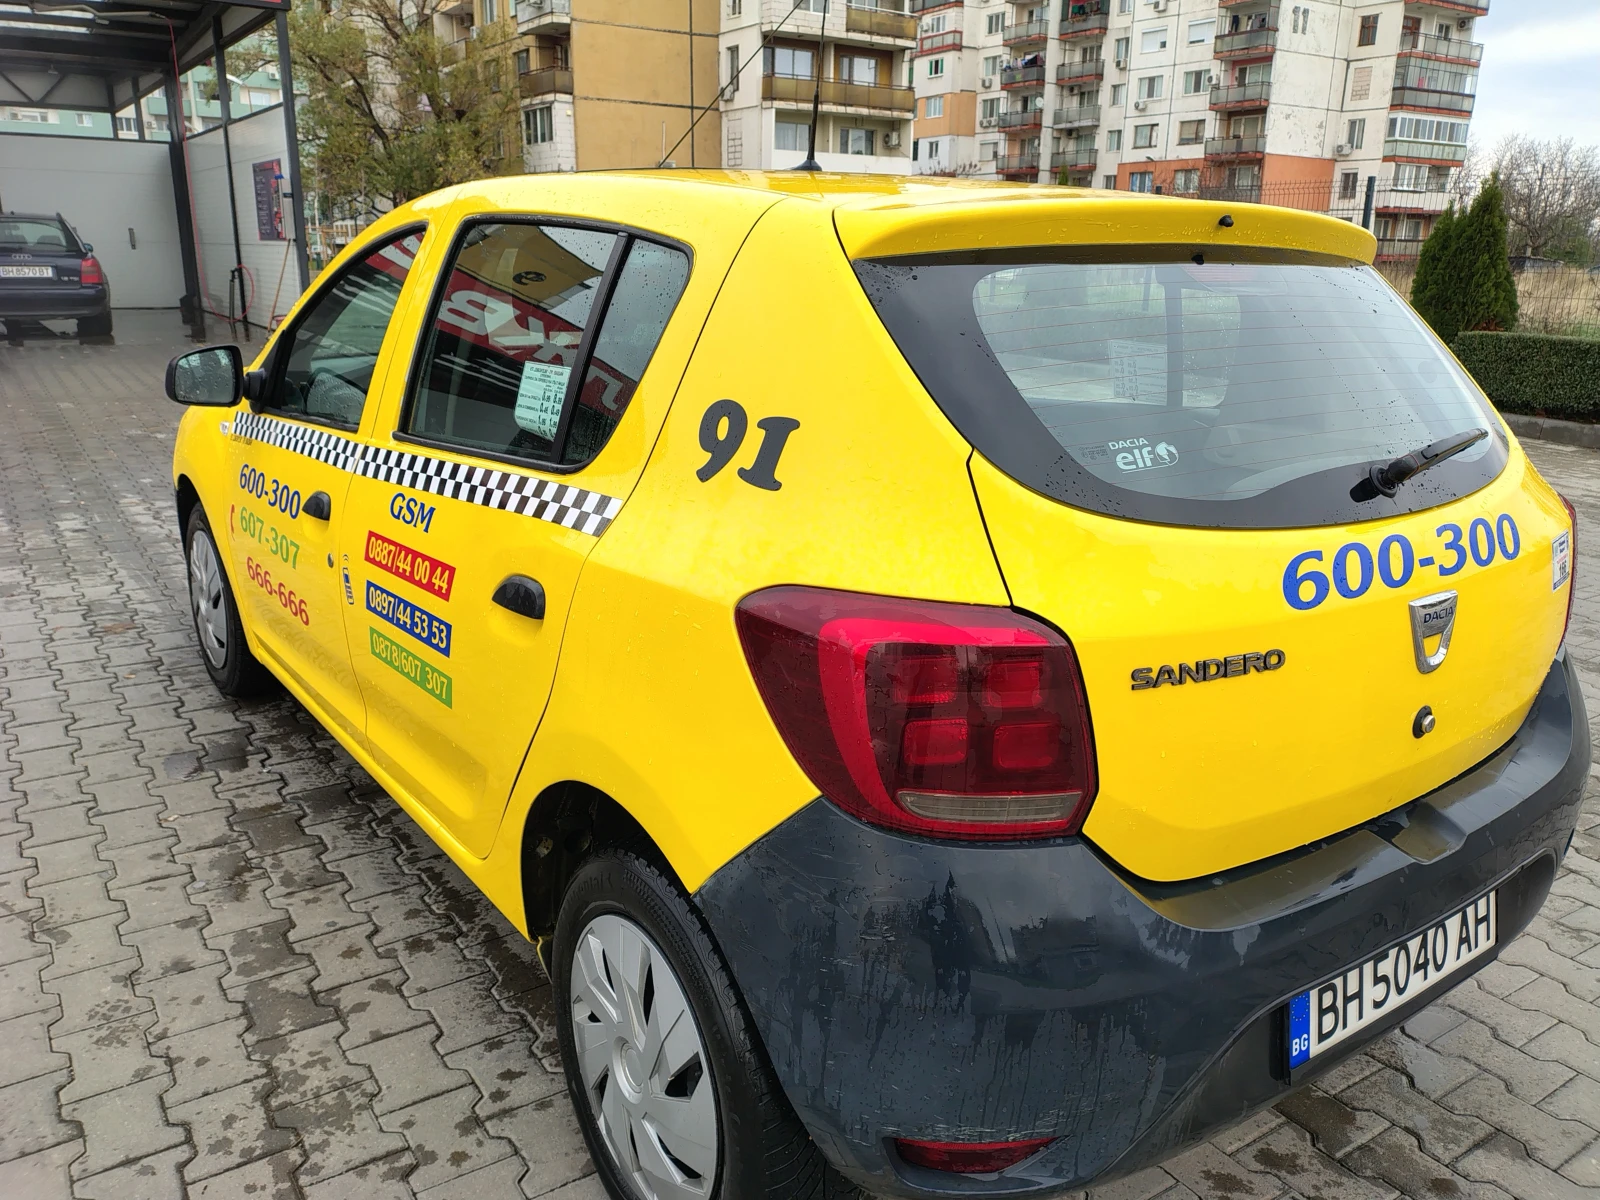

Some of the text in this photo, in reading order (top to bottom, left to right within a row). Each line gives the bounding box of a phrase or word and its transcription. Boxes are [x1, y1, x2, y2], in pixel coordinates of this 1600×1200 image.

[1292, 5, 1310, 36] 11
[696, 399, 801, 491] 91
[1108, 437, 1149, 450] DACIA
[1116, 446, 1154, 470] elf
[239, 463, 301, 520] 600-300
[389, 492, 436, 534] GSM
[239, 506, 300, 570] 607-307
[413, 557, 431, 585] 00
[431, 566, 450, 594] 44
[1282, 513, 1521, 611] 600-300
[246, 556, 310, 626] 666-666
[413, 610, 429, 638] 53
[431, 620, 447, 649] 53
[1423, 606, 1455, 624] DACIA
[425, 667, 448, 700] 307
[1131, 648, 1286, 691] SANDERO
[1317, 891, 1492, 1045] BH 5040 AH
[1292, 1033, 1309, 1057] BG
